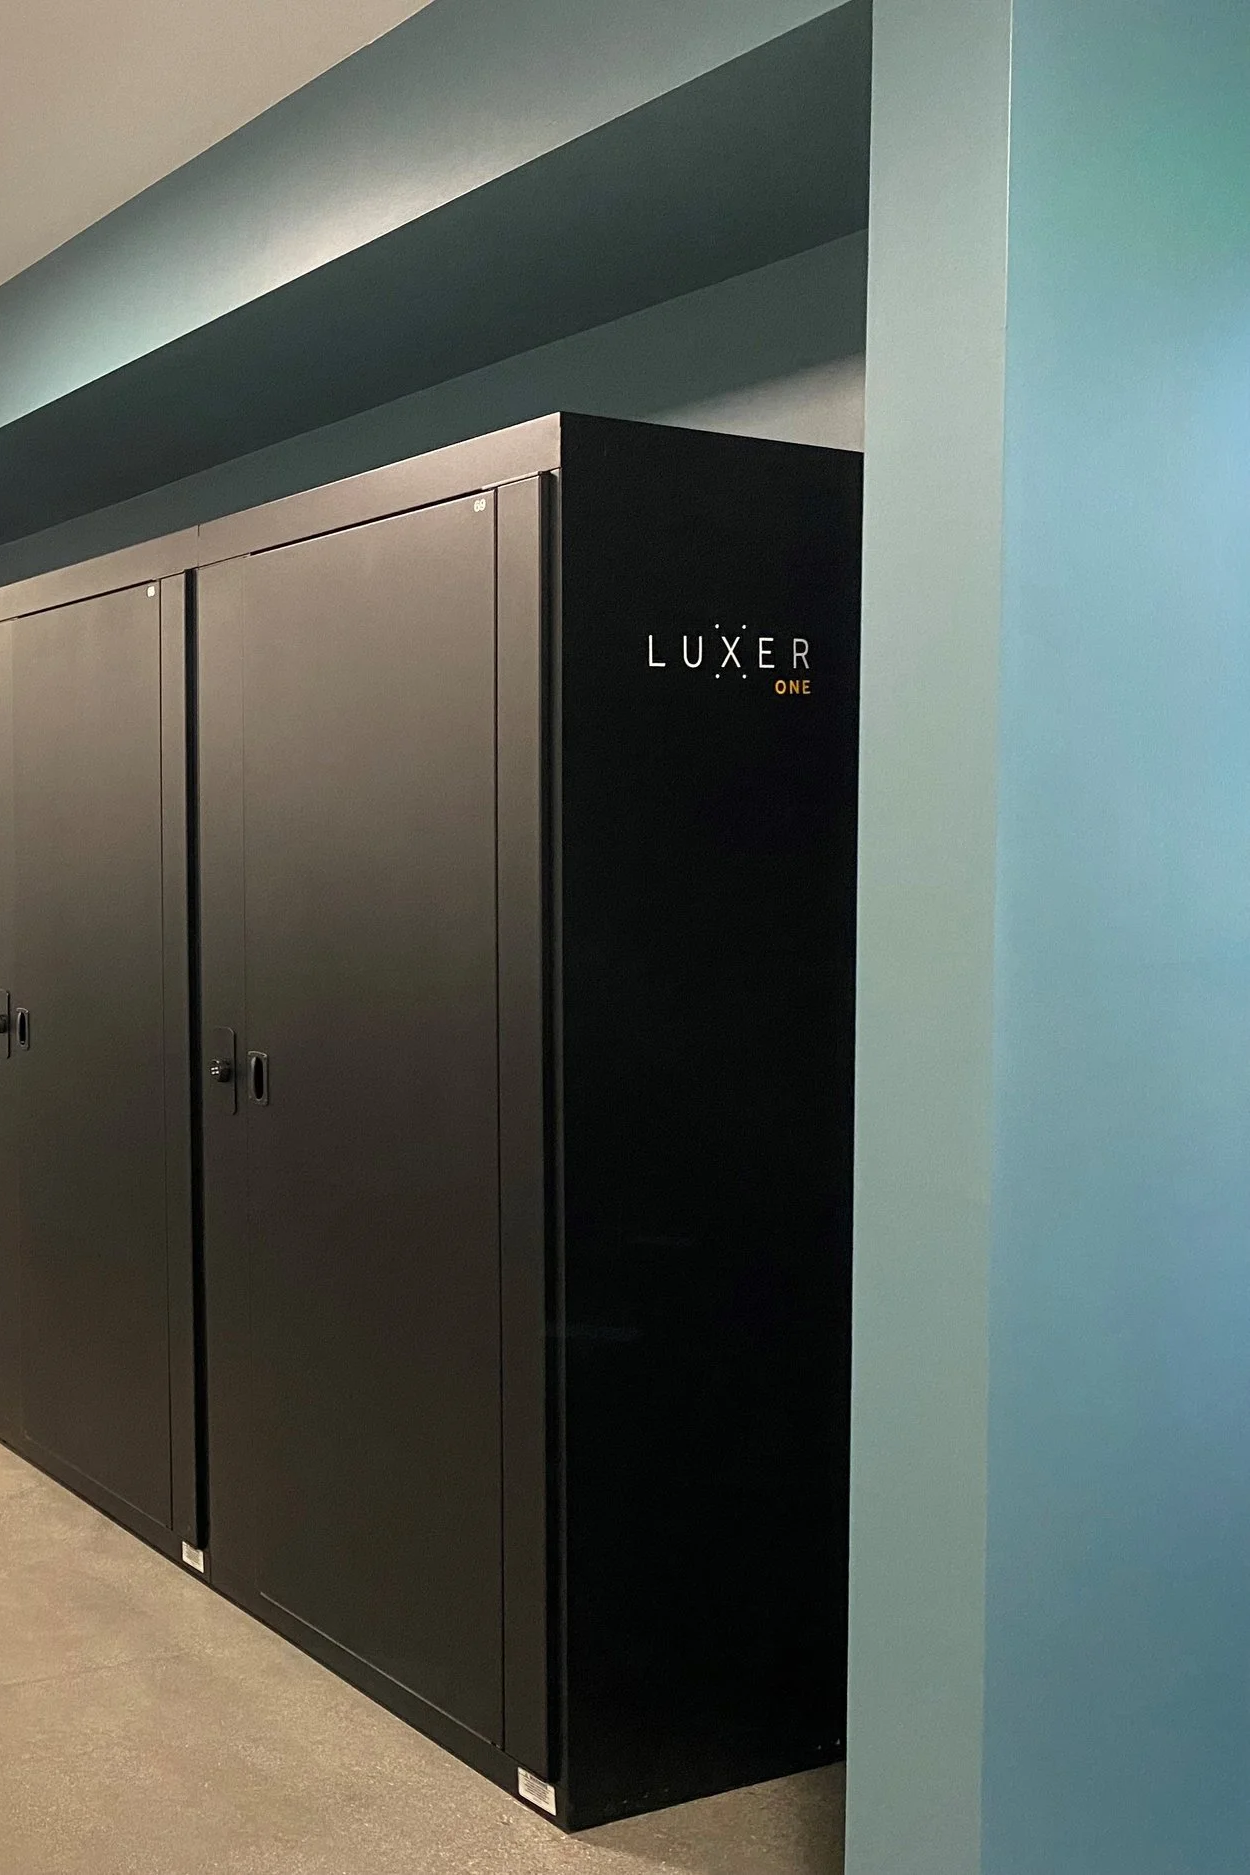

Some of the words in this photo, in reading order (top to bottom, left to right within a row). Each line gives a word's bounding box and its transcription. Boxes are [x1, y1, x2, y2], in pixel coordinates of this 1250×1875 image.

[474, 498, 486, 512] 69
[648, 633, 810, 670] LUXER
[775, 679, 812, 695] ONE
